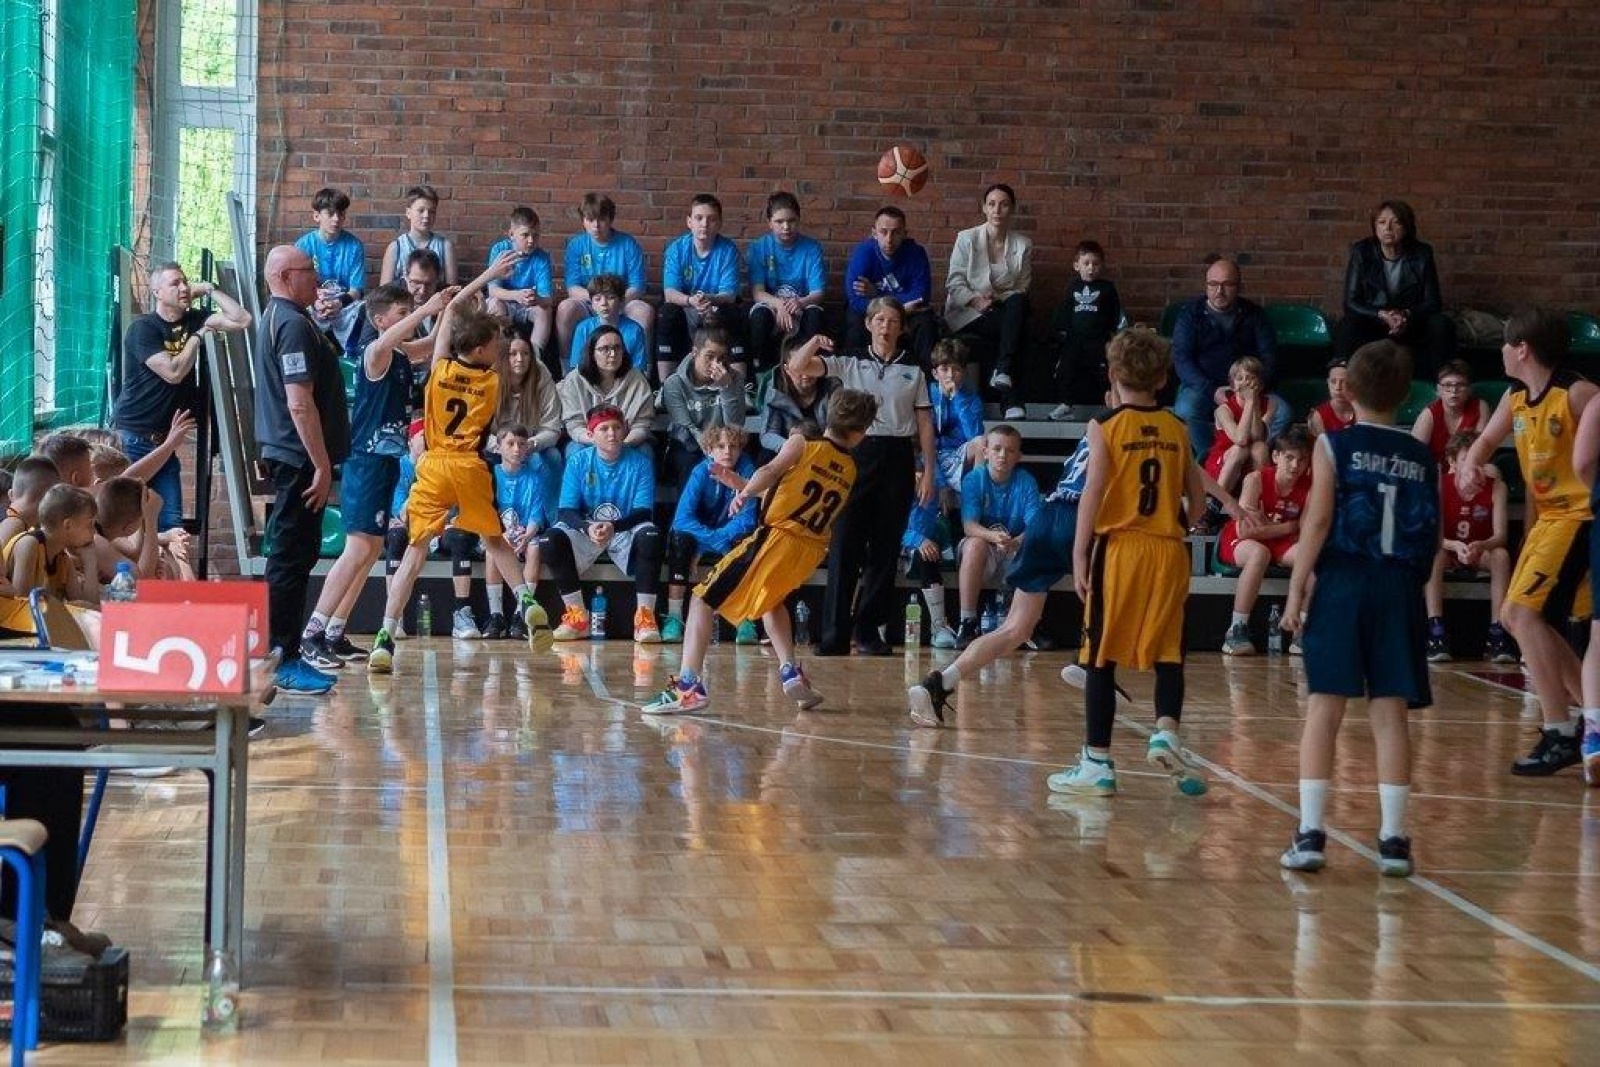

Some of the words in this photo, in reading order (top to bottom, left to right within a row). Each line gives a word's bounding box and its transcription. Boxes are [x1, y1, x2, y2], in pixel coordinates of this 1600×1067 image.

[445, 398, 468, 440] 2
[787, 479, 842, 534] 23
[1138, 458, 1161, 517] 8
[1378, 482, 1397, 554] 1
[1457, 520, 1471, 539] 9
[1524, 571, 1549, 596] 7
[113, 630, 207, 690] 5
